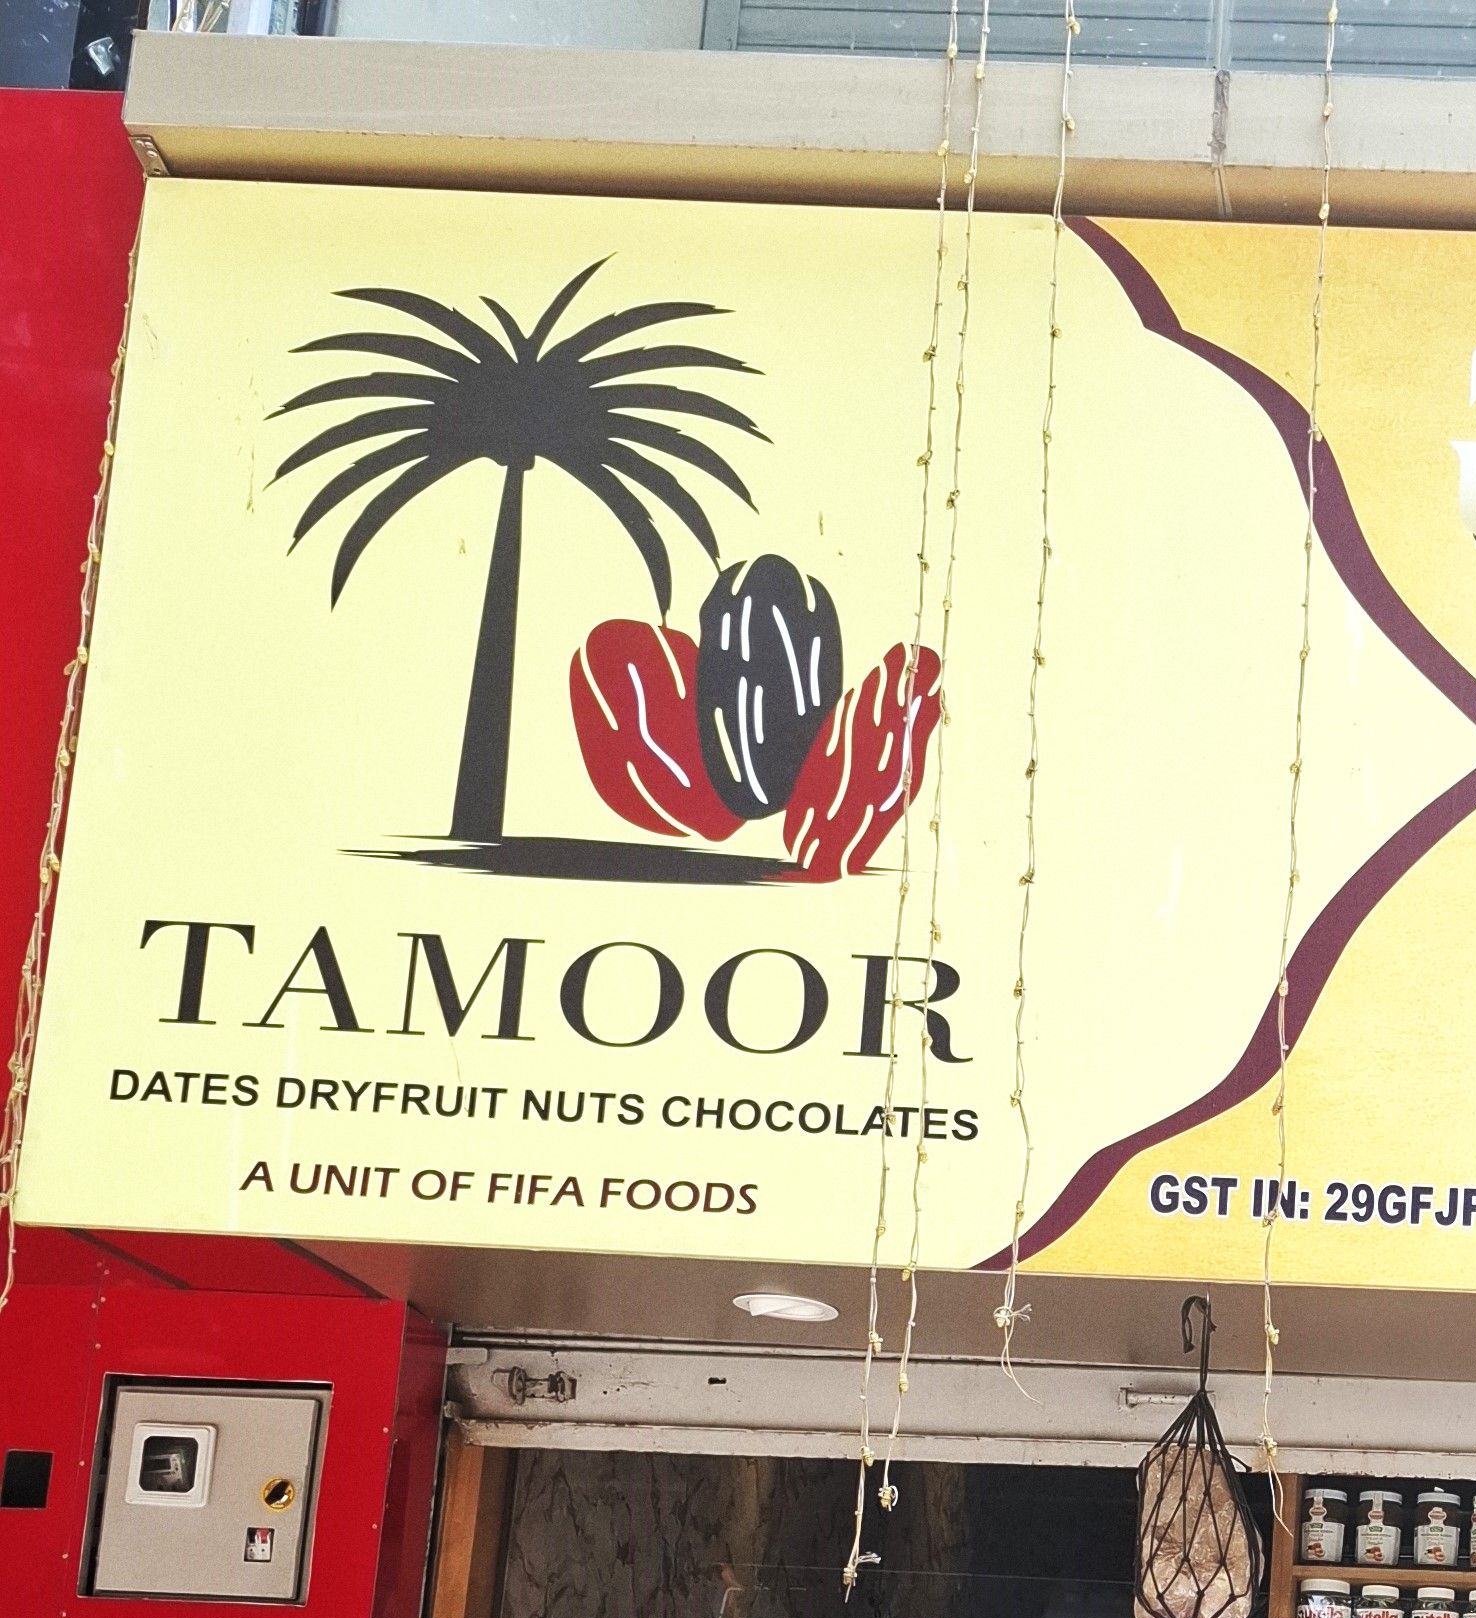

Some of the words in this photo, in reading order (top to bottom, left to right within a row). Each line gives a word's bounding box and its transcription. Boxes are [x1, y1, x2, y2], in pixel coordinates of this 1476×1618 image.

[139, 919, 974, 1064] TAMOOR
[109, 1068, 259, 1107] DATES
[276, 1077, 507, 1120] DRYFRUIT
[522, 1088, 644, 1127] NUTS
[660, 1095, 979, 1142] CHOCOLATES
[239, 1160, 274, 1192] A
[289, 1163, 399, 1199] UNIT
[411, 1170, 474, 1203] OF
[488, 1173, 586, 1208] FIFA
[600, 1178, 759, 1215] FOODS
[1150, 1174, 1237, 1216] GST
[1253, 1178, 1309, 1220] IN:
